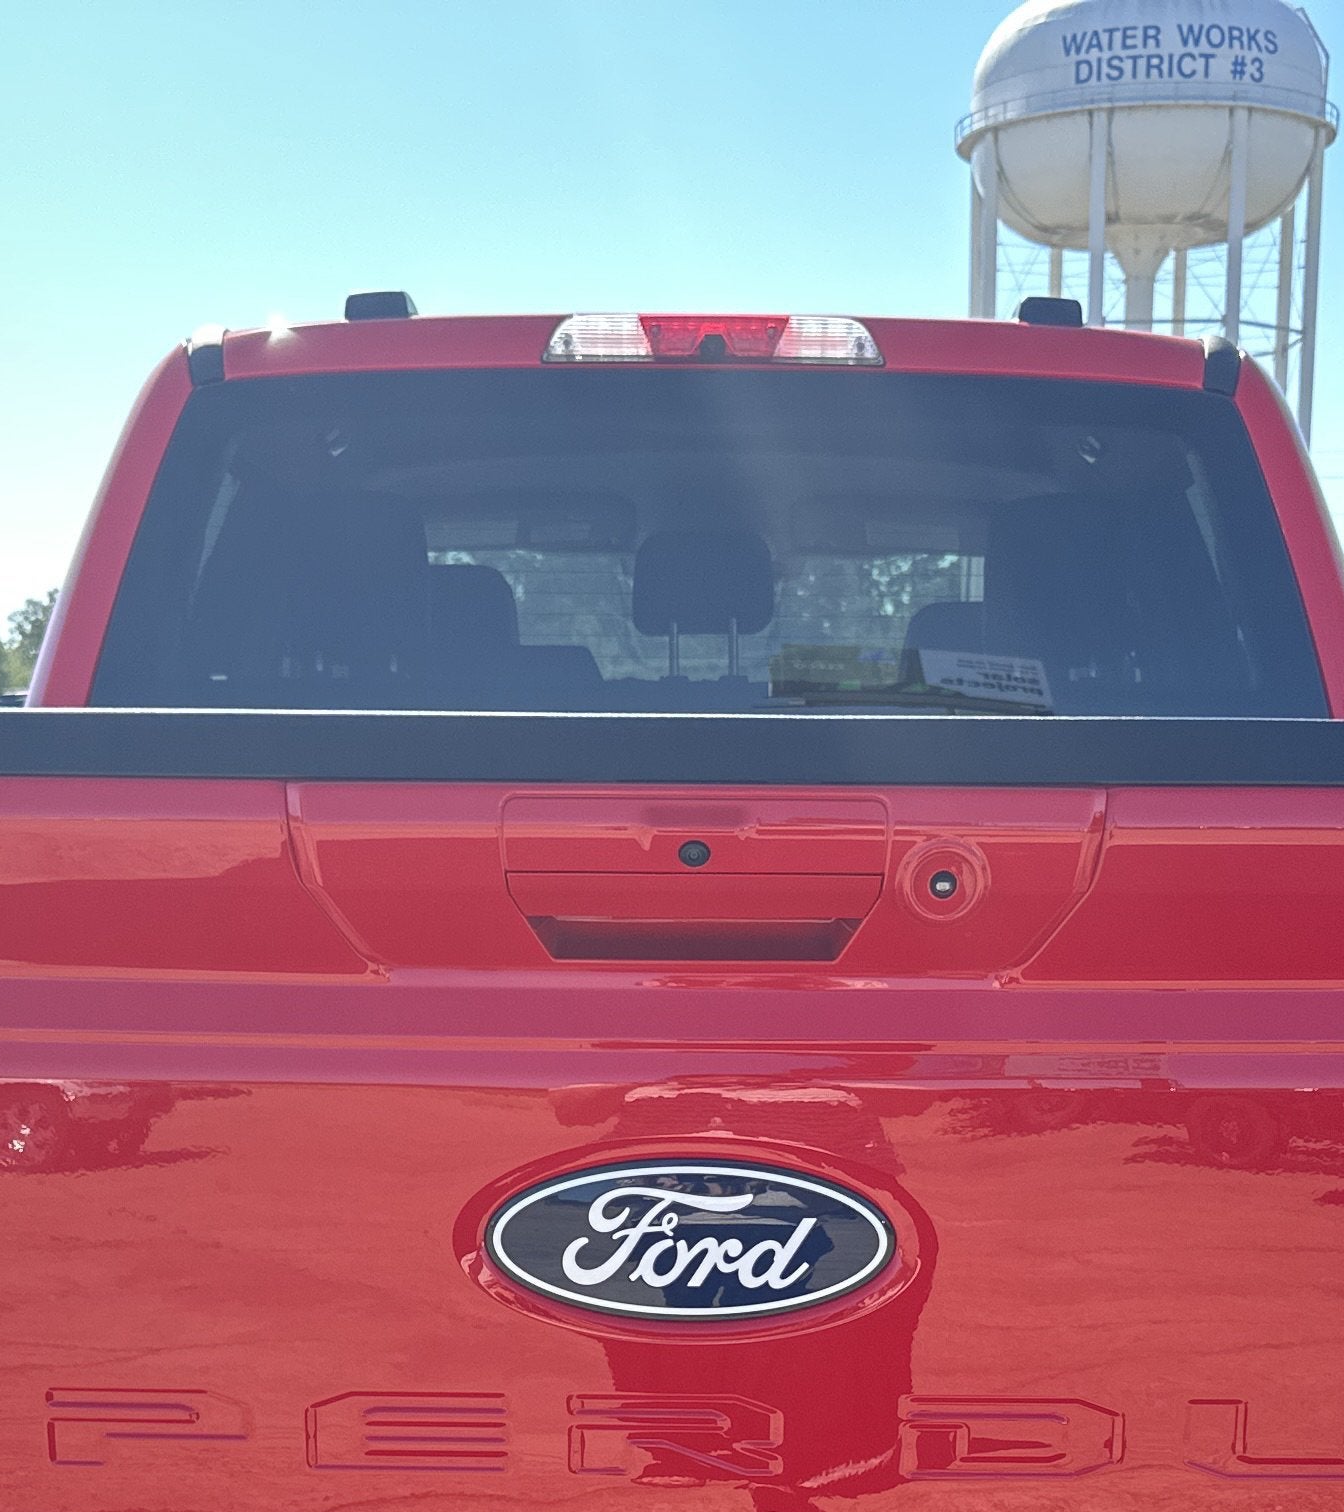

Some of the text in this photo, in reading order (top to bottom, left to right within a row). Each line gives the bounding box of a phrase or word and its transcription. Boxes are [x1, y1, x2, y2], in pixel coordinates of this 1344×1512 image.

[1061, 23, 1279, 57] WATER WORKS
[1074, 53, 1265, 84] DISTRICT #3
[562, 1186, 817, 1290] Ford
